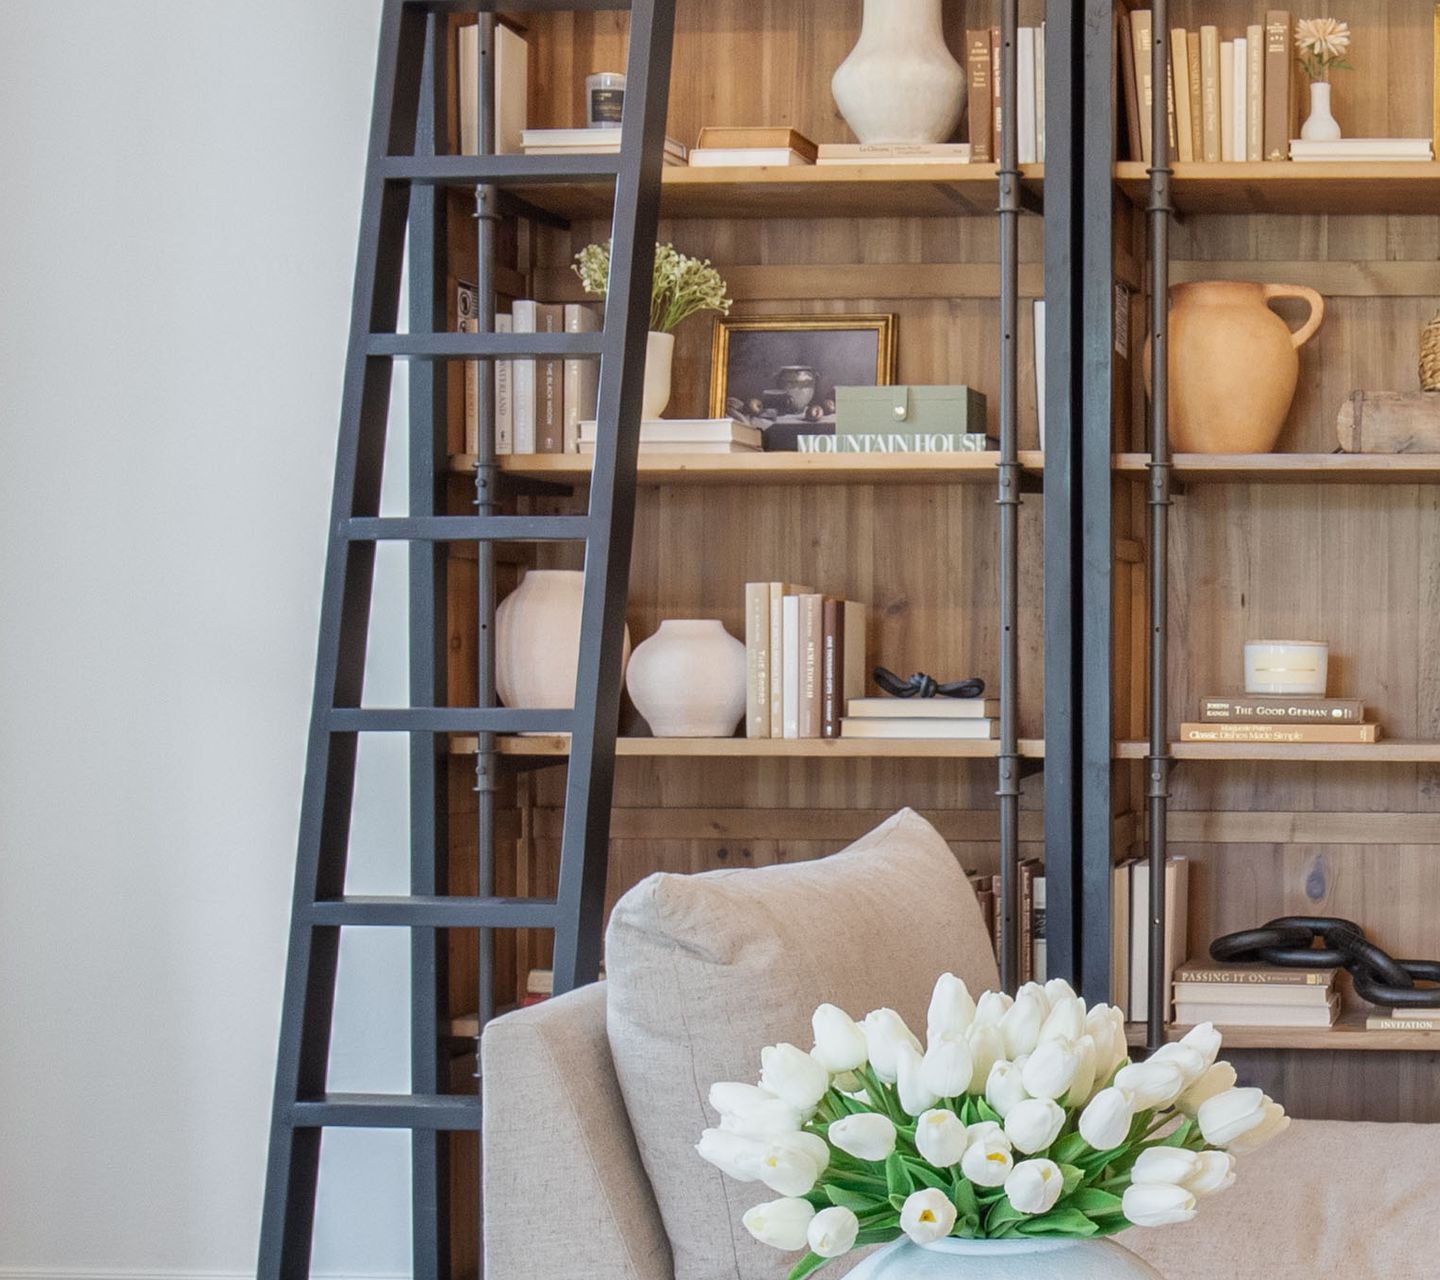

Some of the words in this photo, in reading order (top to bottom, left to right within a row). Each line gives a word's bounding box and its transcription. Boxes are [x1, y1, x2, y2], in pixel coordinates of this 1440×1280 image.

[796, 434, 910, 453] MOUNTAIN
[914, 433, 987, 453] HOUSE
[1234, 705, 1253, 715] THE
[1256, 706, 1285, 716] GOOD
[1288, 707, 1328, 717] GERMAN
[1181, 972, 1230, 982] PASSING
[1233, 973, 1245, 982] IT
[1249, 973, 1266, 982] ON
[1380, 1021, 1433, 1029] INVITATION
